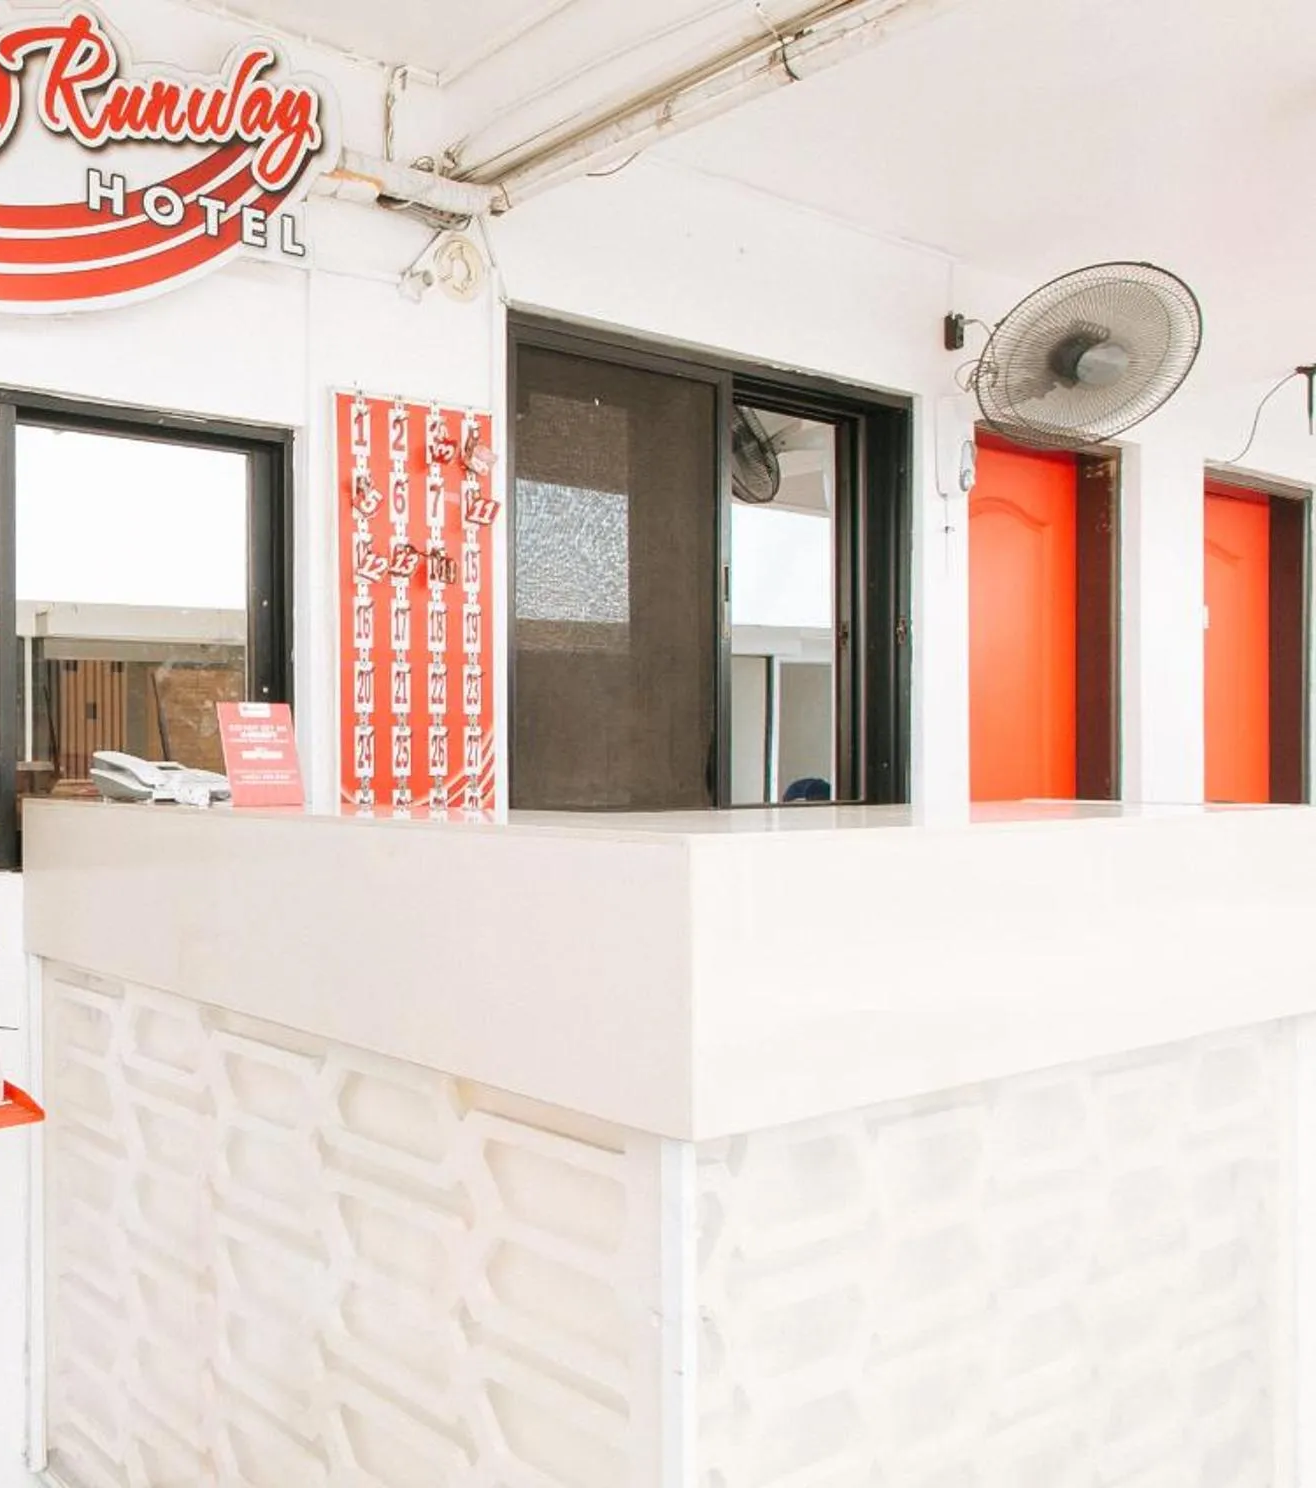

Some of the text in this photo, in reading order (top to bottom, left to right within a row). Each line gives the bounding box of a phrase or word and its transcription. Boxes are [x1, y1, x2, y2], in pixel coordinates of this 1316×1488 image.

[87, 168, 306, 257] HOTEL
[354, 411, 367, 446] 1
[392, 416, 406, 452] 2
[394, 479, 406, 514] 6
[430, 485, 441, 517] 7
[395, 607, 406, 641] 17
[430, 610, 443, 643] 18
[466, 612, 478, 644] 19
[358, 670, 371, 704] 20
[395, 671, 408, 704] 21
[431, 673, 444, 704] 22
[358, 734, 480, 769] 24 25 26 27
